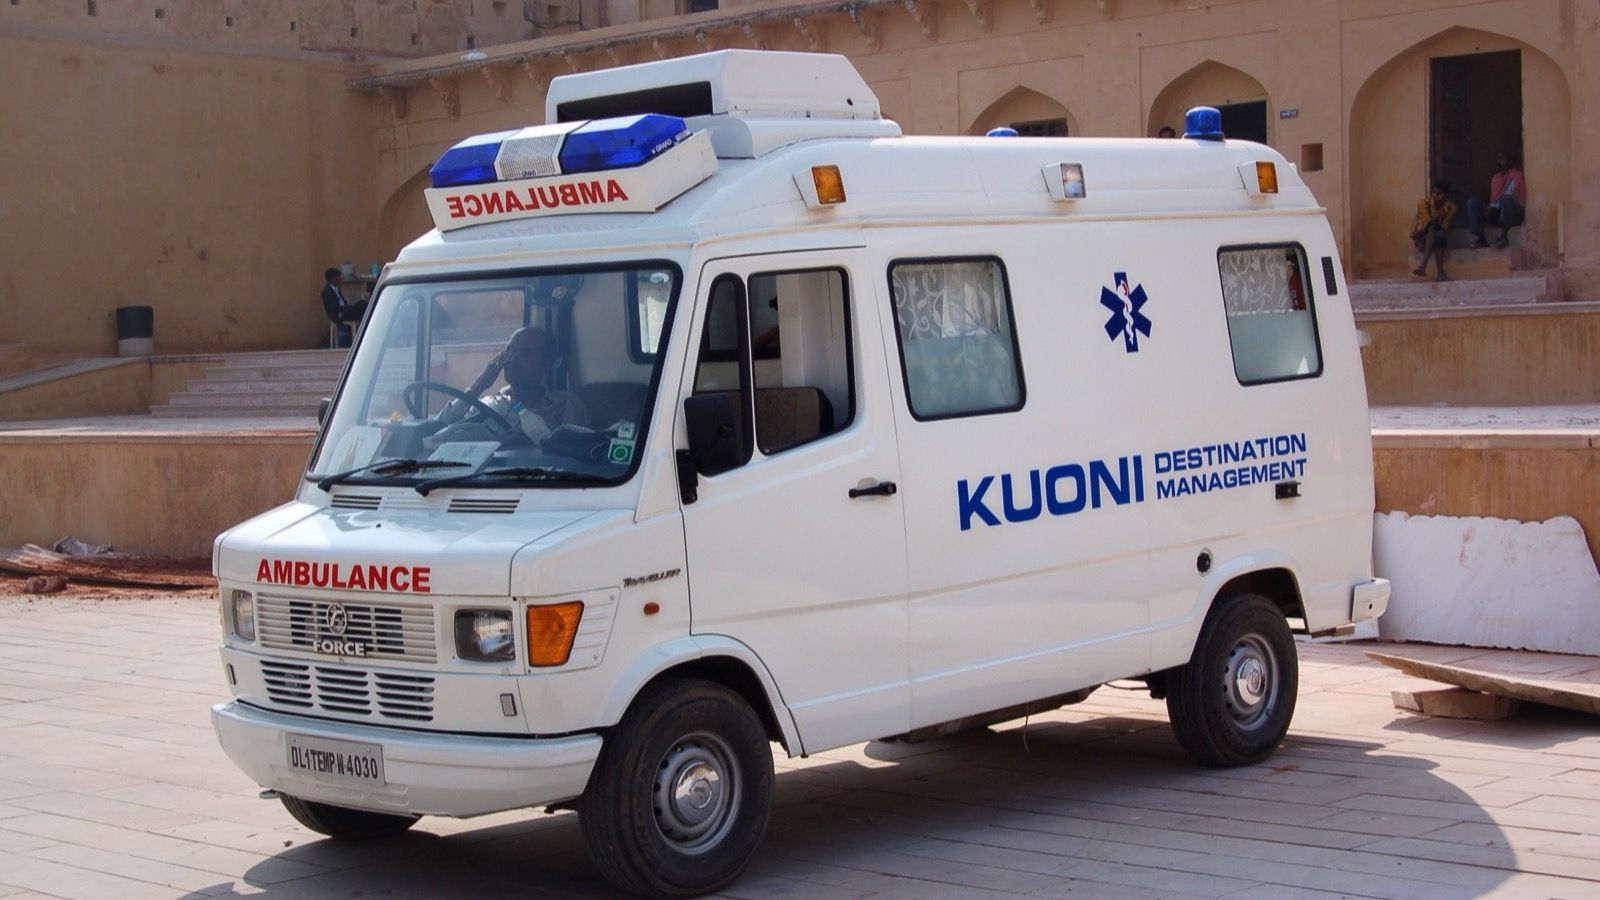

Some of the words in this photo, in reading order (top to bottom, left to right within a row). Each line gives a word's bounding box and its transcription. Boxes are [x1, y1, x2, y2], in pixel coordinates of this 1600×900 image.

[957, 455, 1145, 531] KUONI
[1154, 433, 1307, 474] DESTINATION
[1156, 458, 1307, 500] MANAGEMENT
[256, 559, 431, 593] AMBULANCE
[313, 639, 365, 656] FORCE
